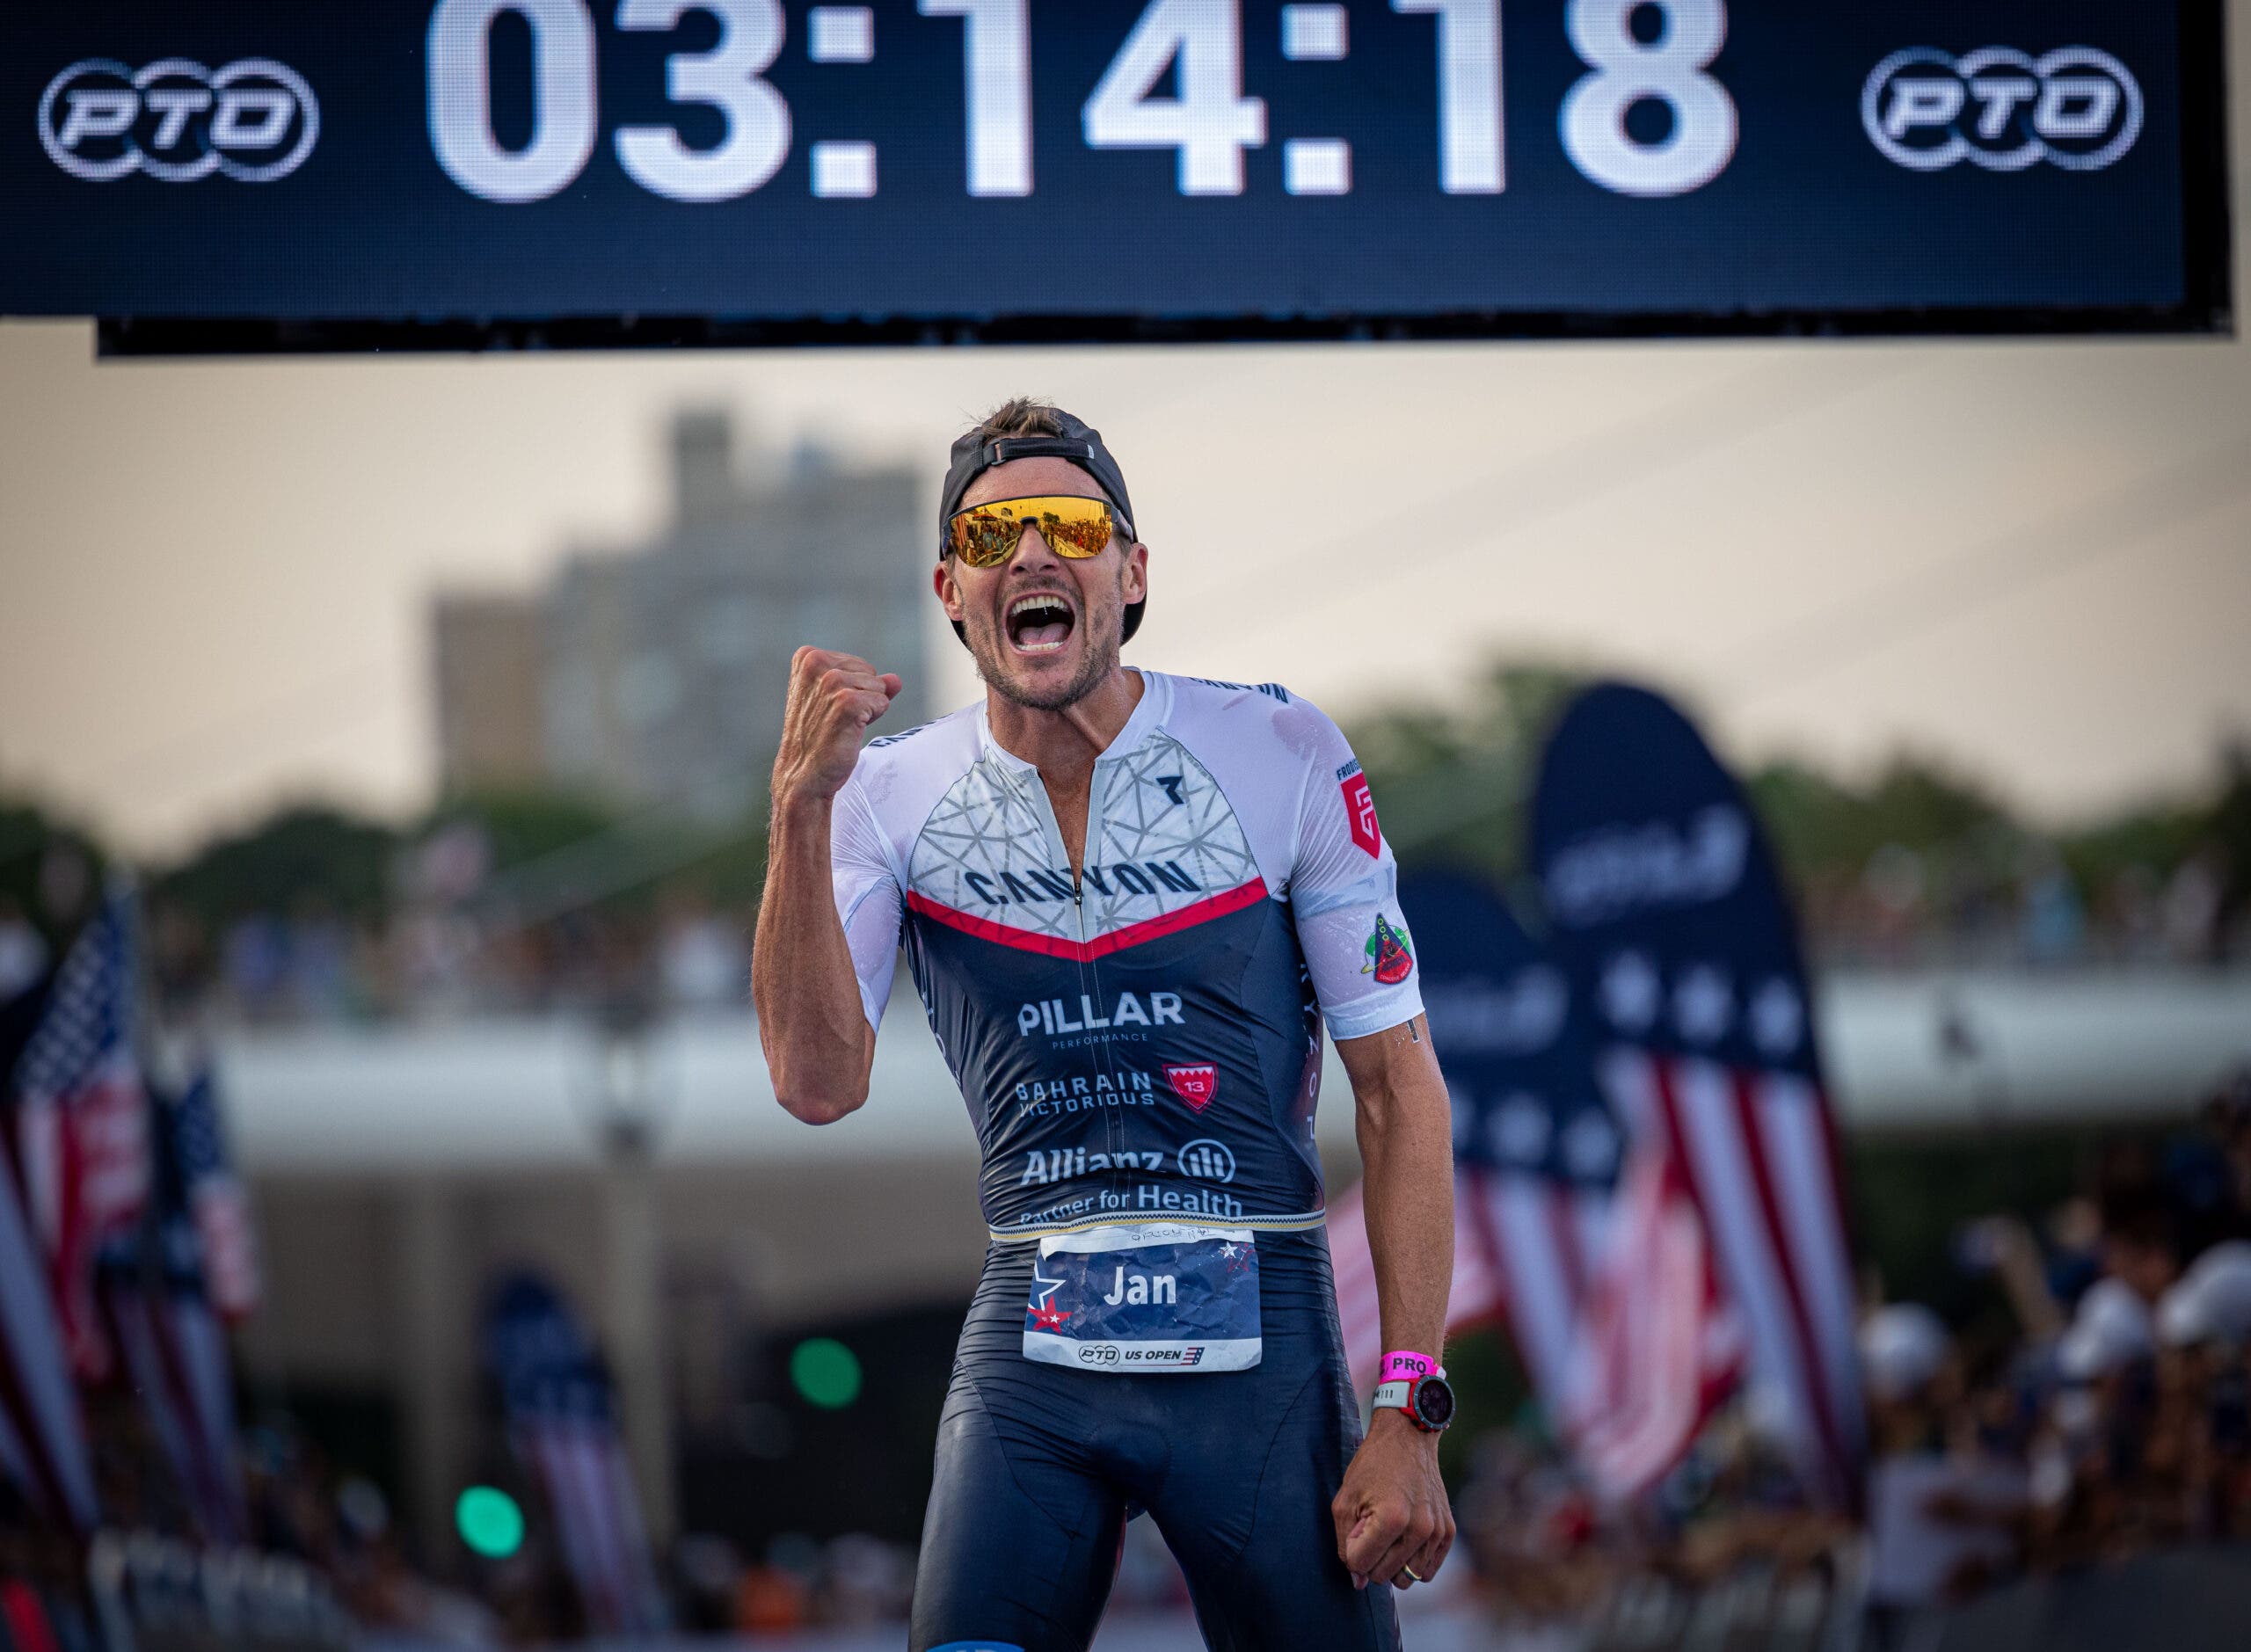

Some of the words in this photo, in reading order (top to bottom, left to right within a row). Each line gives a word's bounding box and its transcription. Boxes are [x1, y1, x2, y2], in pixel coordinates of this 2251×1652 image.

[425, 0, 1739, 203] 03:14:18
[965, 860, 1202, 904] CANYON
[1017, 992, 1186, 1037] PILLAR
[1053, 1033, 1148, 1050] PERFORMANCE
[1016, 1072, 1152, 1101] BAHRAIN
[1184, 1081, 1205, 1092] 13
[1019, 1092, 1155, 1117] VICTORIOUS
[1020, 1146, 1164, 1186] Allianz
[1020, 1196, 1094, 1225] Partner
[1099, 1190, 1130, 1209] for
[1138, 1184, 1242, 1218] Health
[1103, 1265, 1177, 1306] Jan
[1125, 1350, 1142, 1360] US
[1145, 1350, 1182, 1360] OPEN
[1393, 1357, 1427, 1374] PRO
